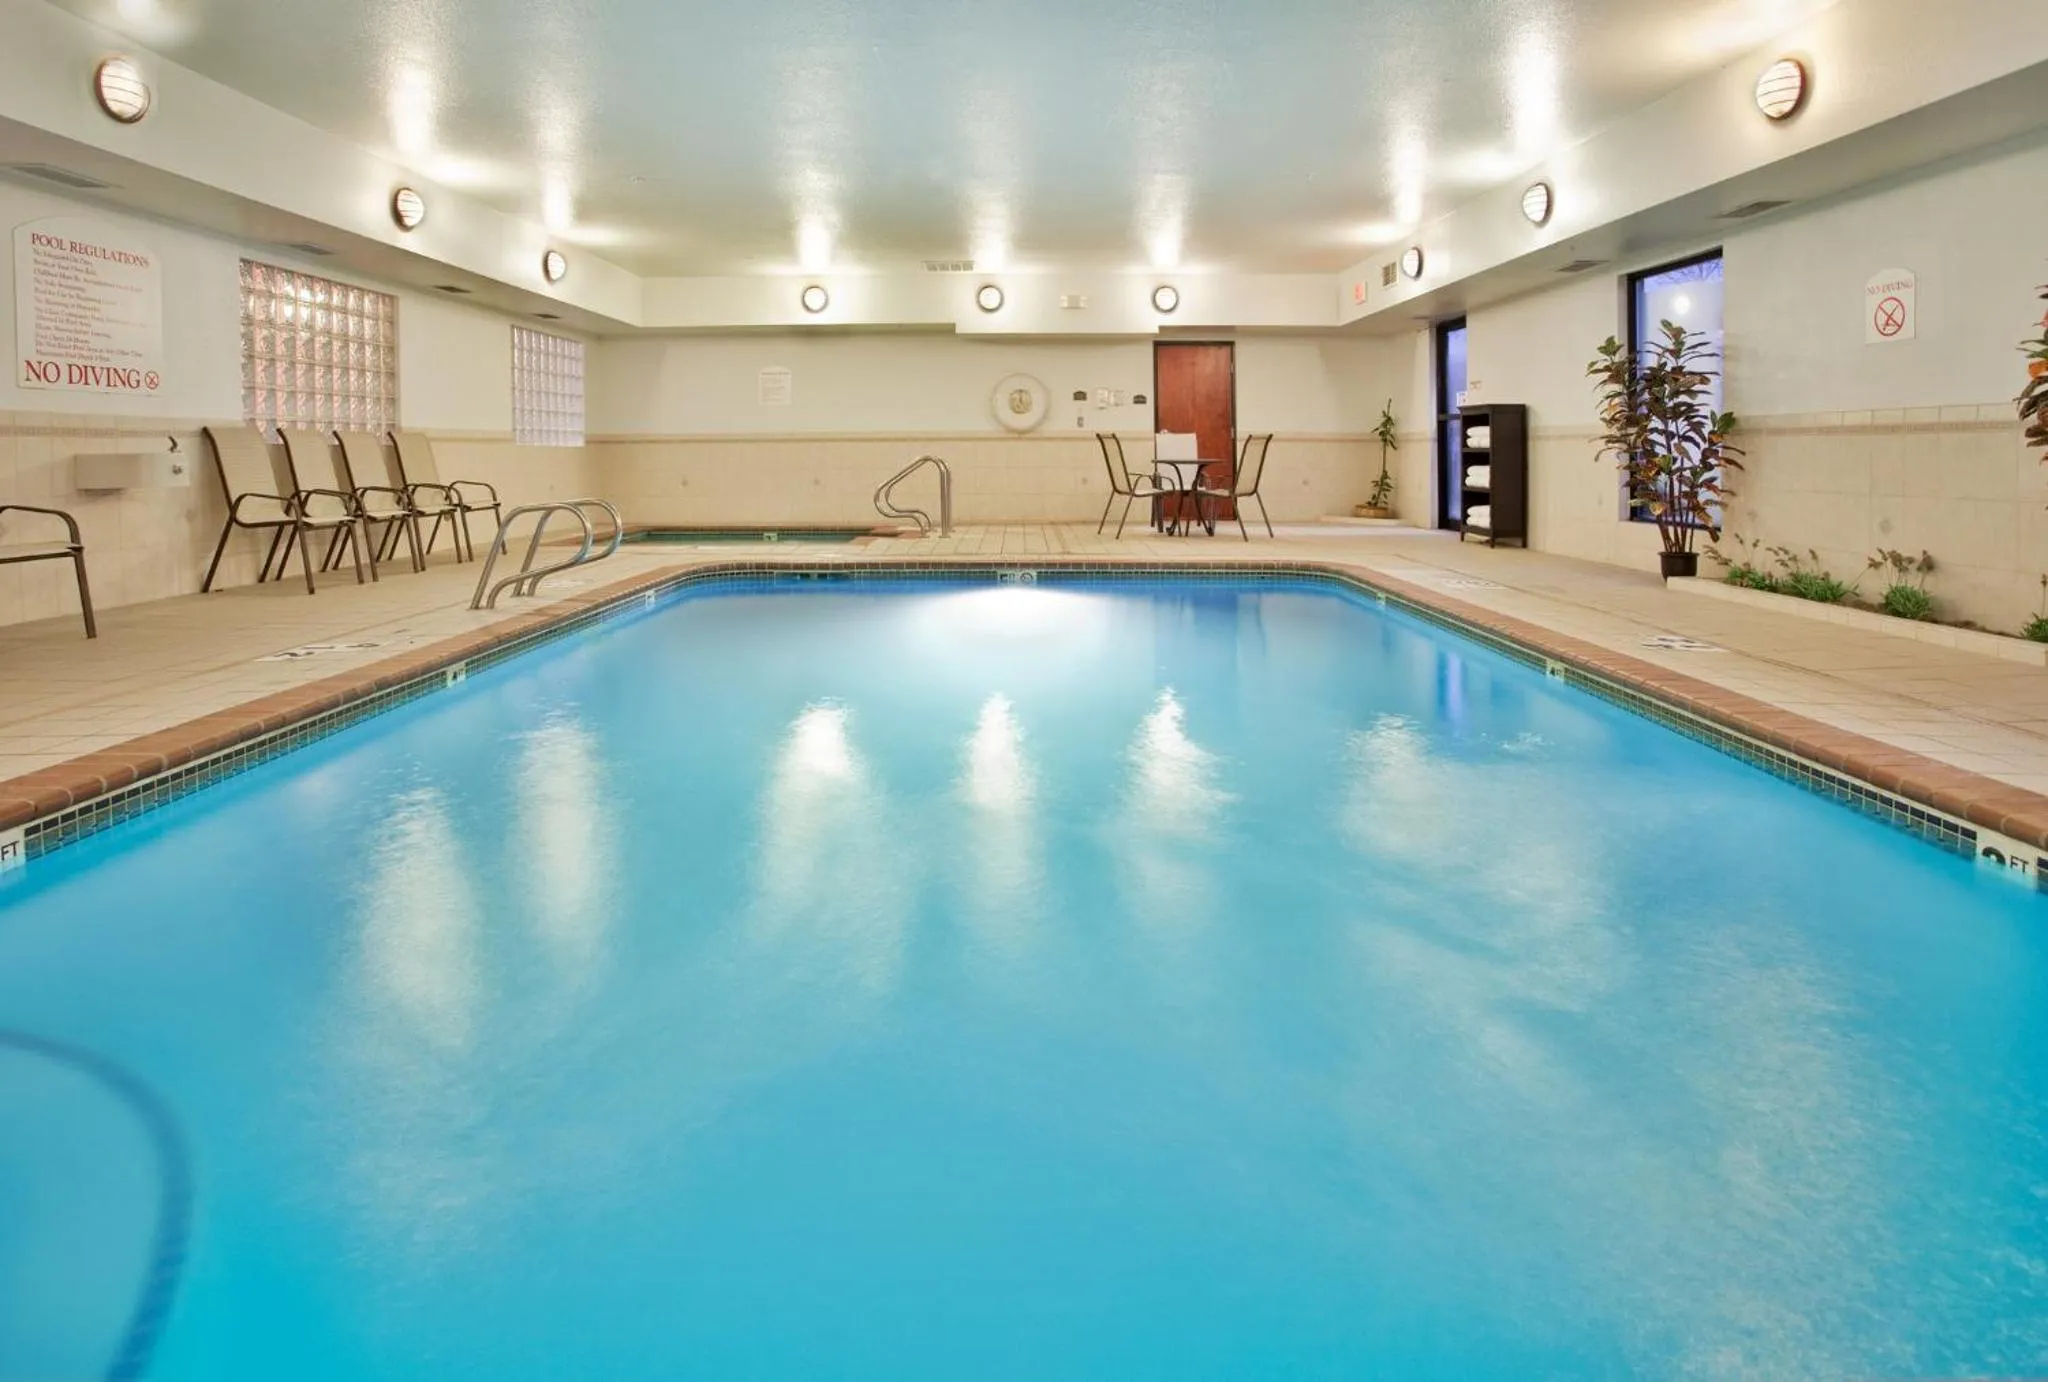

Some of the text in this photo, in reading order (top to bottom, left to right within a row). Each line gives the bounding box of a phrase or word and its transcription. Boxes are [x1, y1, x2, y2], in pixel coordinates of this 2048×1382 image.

[32, 232, 66, 251] POOL
[70, 241, 150, 268] REGULATIONS
[24, 360, 141, 389] NO DIVING
[1, 840, 19, 861] FT
[2010, 854, 2029, 873] FT
